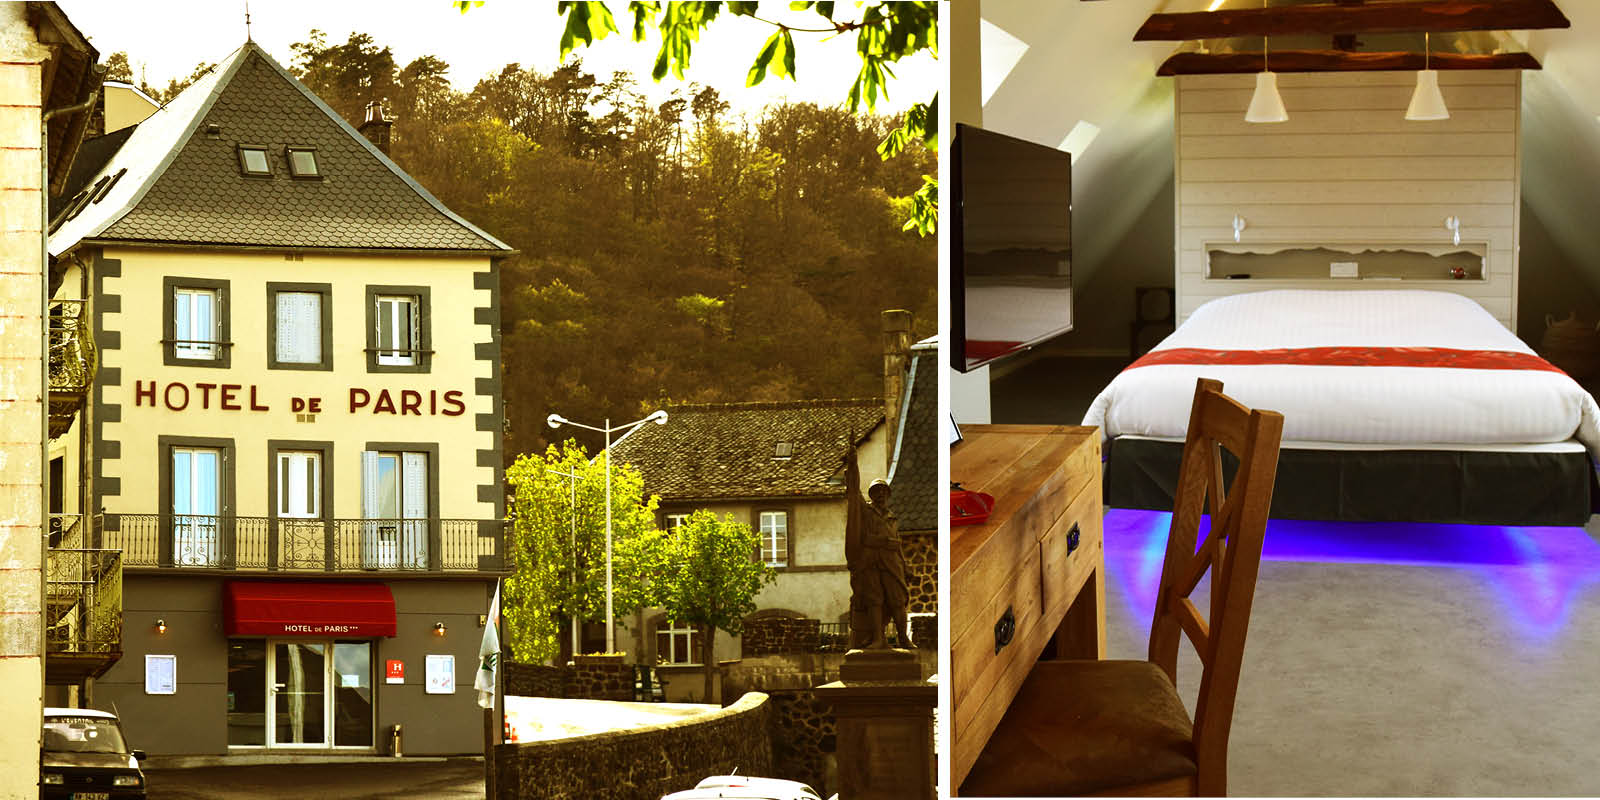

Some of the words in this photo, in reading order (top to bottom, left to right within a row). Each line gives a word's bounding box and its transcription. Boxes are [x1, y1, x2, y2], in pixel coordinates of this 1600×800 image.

[135, 380, 270, 412] HOTEL
[291, 397, 322, 413] DE
[349, 387, 466, 417] PARIS
[284, 624, 313, 633] HOTEL
[324, 625, 349, 633] PARIS
[393, 663, 402, 671] H
